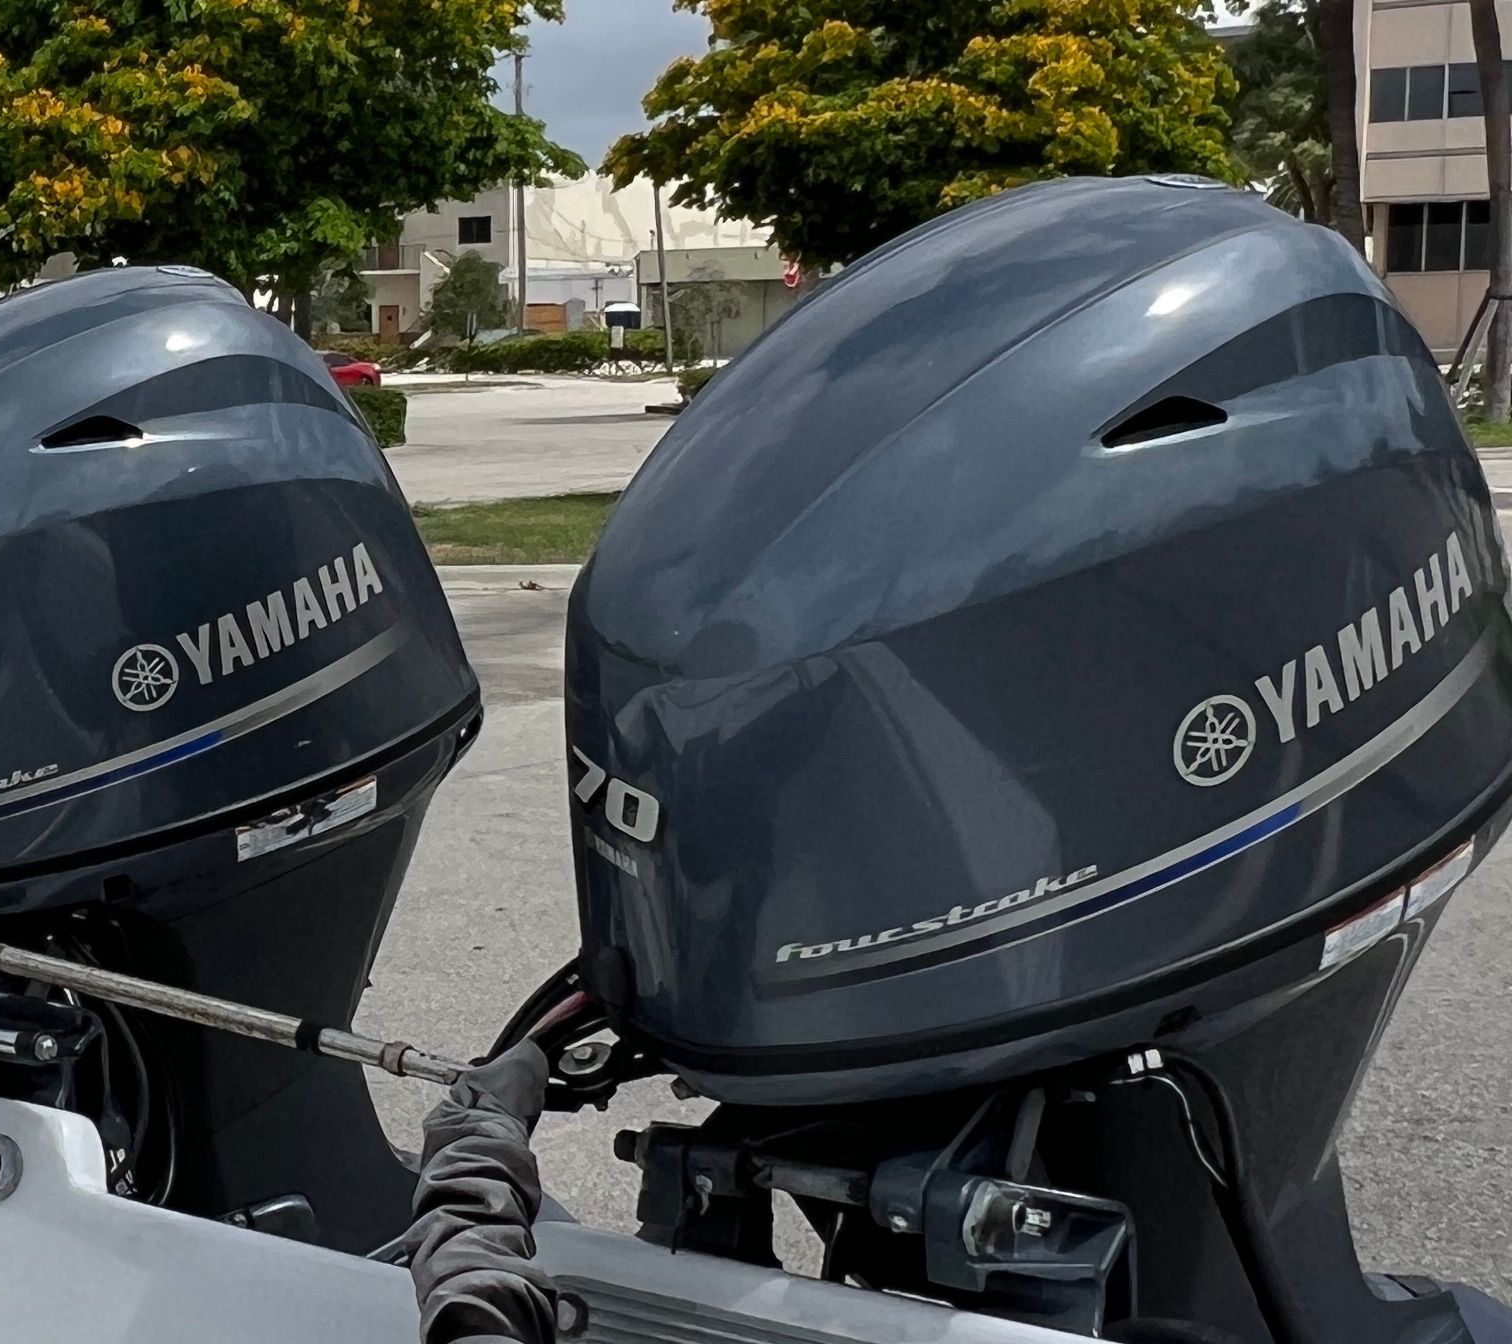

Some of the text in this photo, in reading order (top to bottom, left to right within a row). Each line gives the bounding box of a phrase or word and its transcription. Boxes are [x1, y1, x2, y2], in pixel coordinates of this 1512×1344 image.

[176, 542, 383, 685] YAMAHA
[1254, 531, 1473, 744] YAMAHA
[572, 745, 660, 843] 70
